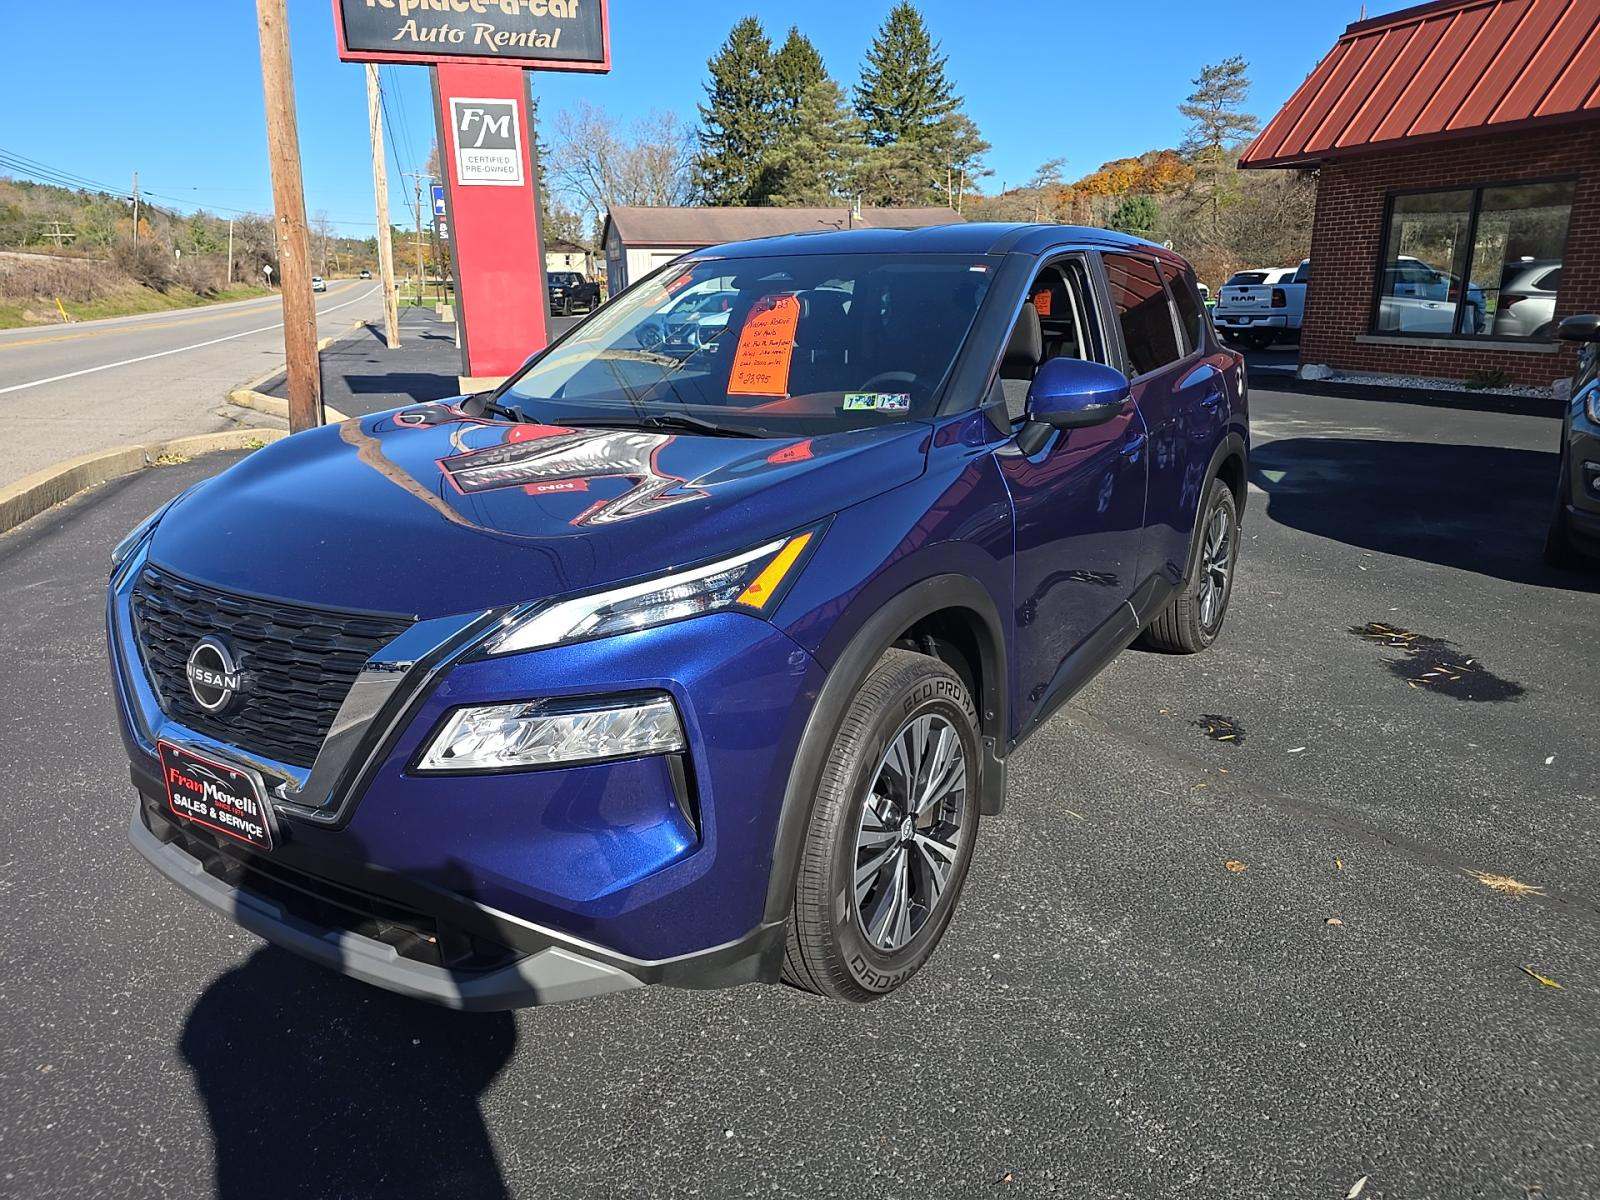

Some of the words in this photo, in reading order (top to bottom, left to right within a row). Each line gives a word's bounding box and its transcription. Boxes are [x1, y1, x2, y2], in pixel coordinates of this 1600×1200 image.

[392, 19, 466, 43] Auto
[471, 23, 562, 52] Rental
[460, 108, 511, 148] FM
[465, 164, 515, 174] PRE-OWNED
[467, 155, 510, 165] CERTIFIED
[187, 664, 237, 689] NISSAN
[903, 682, 932, 714] ECO
[936, 680, 962, 701] PRO
[173, 793, 208, 815] SALES
[209, 808, 218, 819] &
[218, 811, 263, 838] SERVICE
